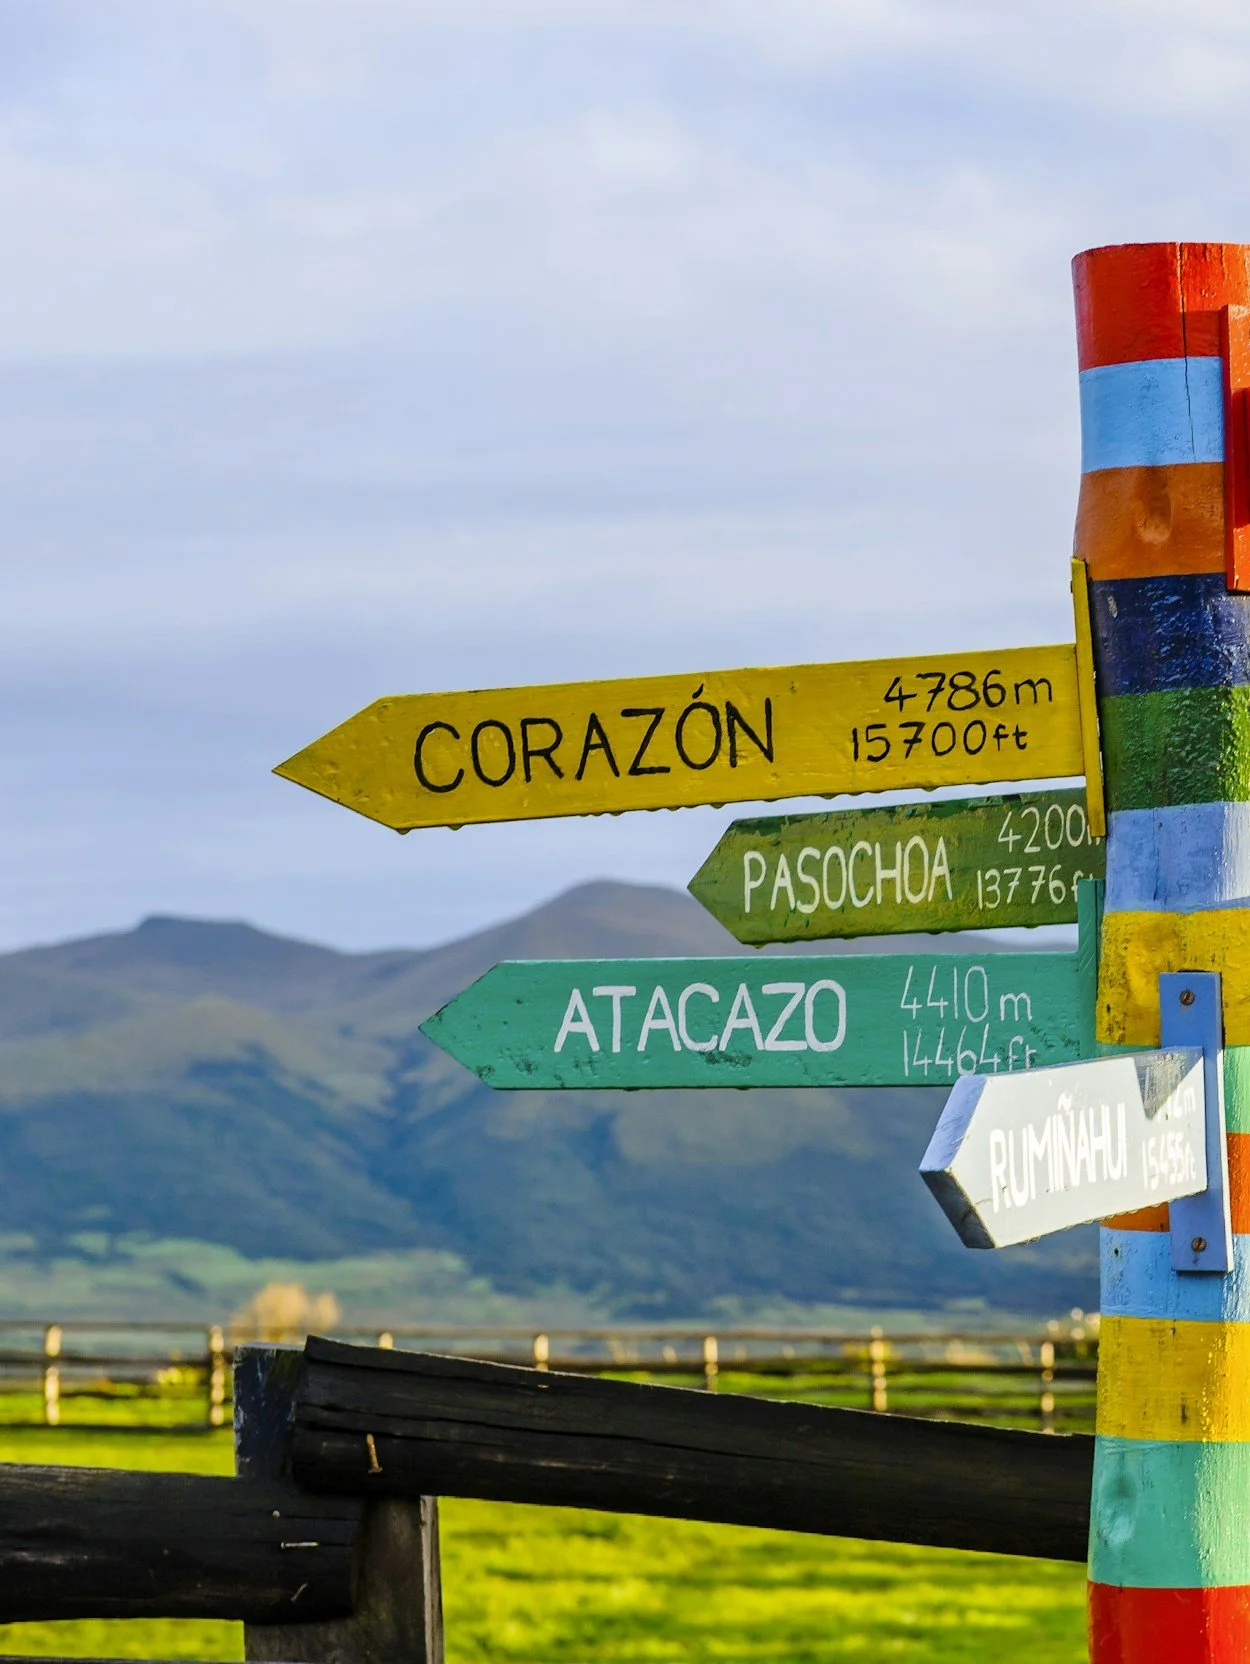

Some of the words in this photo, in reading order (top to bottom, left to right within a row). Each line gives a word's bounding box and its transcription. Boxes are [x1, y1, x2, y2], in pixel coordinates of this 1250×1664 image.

[883, 669, 1053, 712] 4786m
[414, 684, 776, 793] CORAZÓN
[852, 719, 1028, 763] 15700ft
[744, 835, 954, 914] PASOCHOA
[977, 864, 1094, 911] 13776f
[553, 978, 848, 1053] ATACAZO
[989, 1090, 1128, 1214] RUMIÑAHUI
